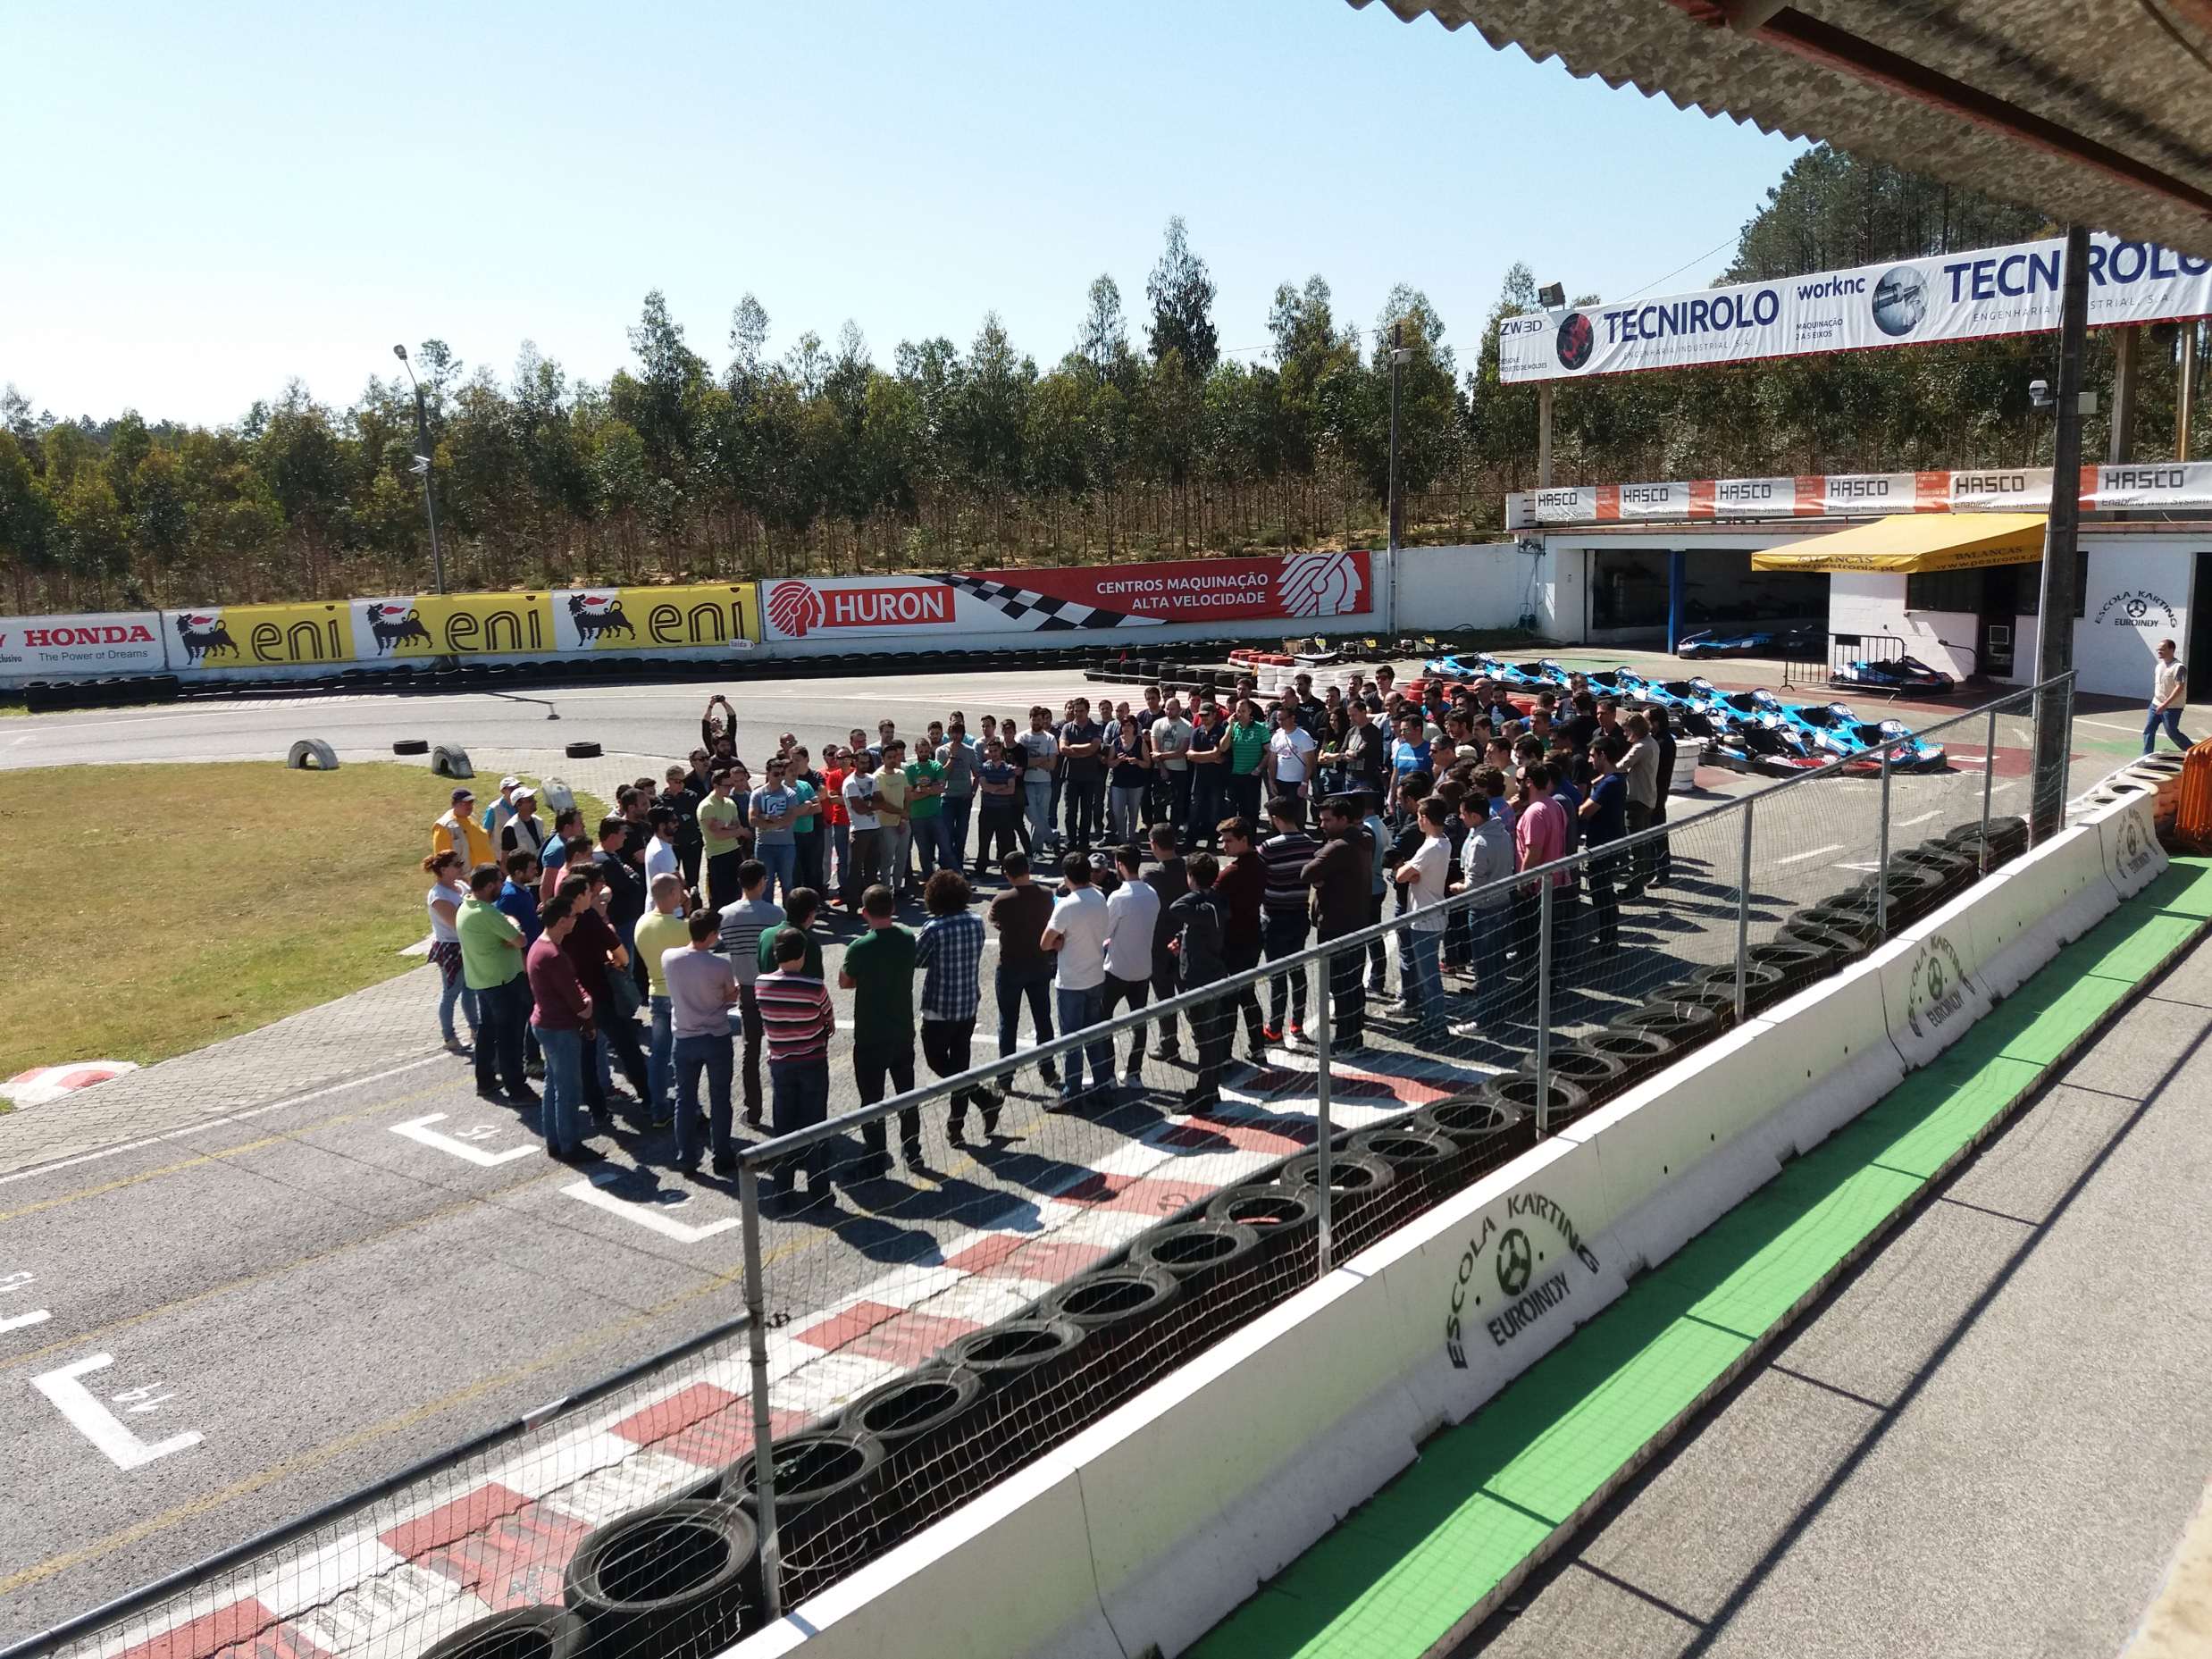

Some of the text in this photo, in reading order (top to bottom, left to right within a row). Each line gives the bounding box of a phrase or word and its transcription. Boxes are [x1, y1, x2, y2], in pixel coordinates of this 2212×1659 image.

[1944, 242, 2212, 303] TECNROL
[1797, 275, 1865, 301] worknc
[1604, 289, 1780, 344] TECNIROLO
[1973, 306, 2051, 323] ENGENHARIA
[2058, 298, 2141, 314] ISTRIAL,
[1501, 320, 1542, 336] ZW3D
[1796, 317, 1843, 330] MAQUINAÇÃO
[1813, 331, 1832, 339] EIXOS
[1831, 480, 1889, 497] HASCO
[1955, 476, 2024, 494] HASCO
[2105, 470, 2183, 490] HASCO
[1538, 492, 1578, 507] HASCO
[1623, 488, 1669, 503] HASCO
[1720, 484, 1772, 500] HASCO
[1096, 572, 1269, 594] CENTROS MAQUINAÇÃO
[835, 591, 944, 623] HURON
[1132, 591, 1266, 610] ALTA VELOCIDADE
[2094, 590, 2178, 628] ESCOLA KARTING
[446, 595, 541, 651] eni
[649, 586, 745, 643] eni
[2115, 617, 2159, 627] EUROINDY
[23, 625, 155, 647] HONDA
[251, 605, 342, 662] eni
[39, 652, 58, 662] The
[62, 652, 93, 661] Power
[108, 650, 148, 659] Dreams
[1446, 1192, 1601, 1370] ESCOLA KARTING
[1486, 1271, 1571, 1347] EUROINDY
